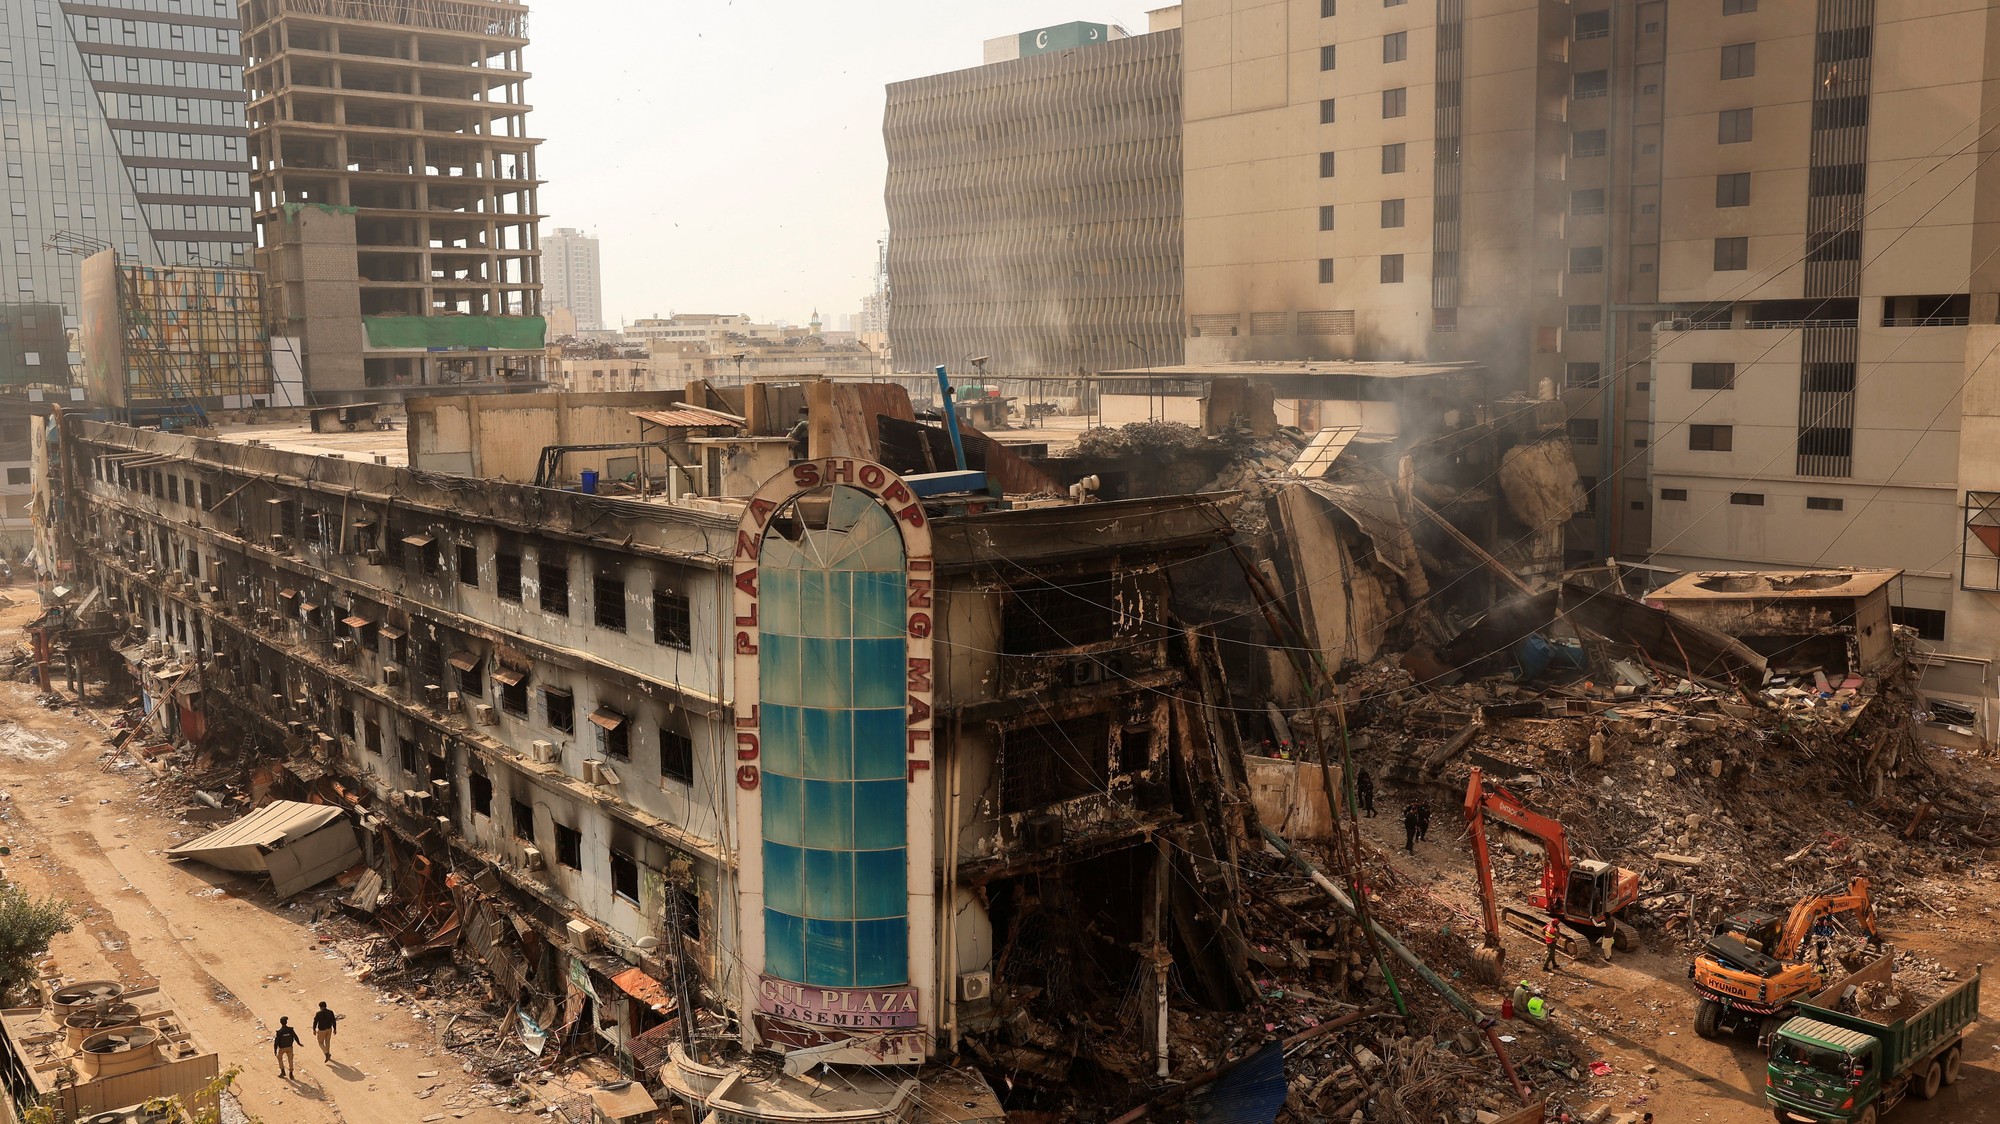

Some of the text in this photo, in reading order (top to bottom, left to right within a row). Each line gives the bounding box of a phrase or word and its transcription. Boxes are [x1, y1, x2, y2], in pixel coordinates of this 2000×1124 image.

[735, 498, 777, 655] PLAZA
[736, 704, 760, 791] GUL
[908, 657, 931, 783] MALL
[760, 980, 918, 1013] GUL PLAZA
[774, 1003, 901, 1026] BASEMENT
[1708, 978, 1747, 997] HYUNDAI
